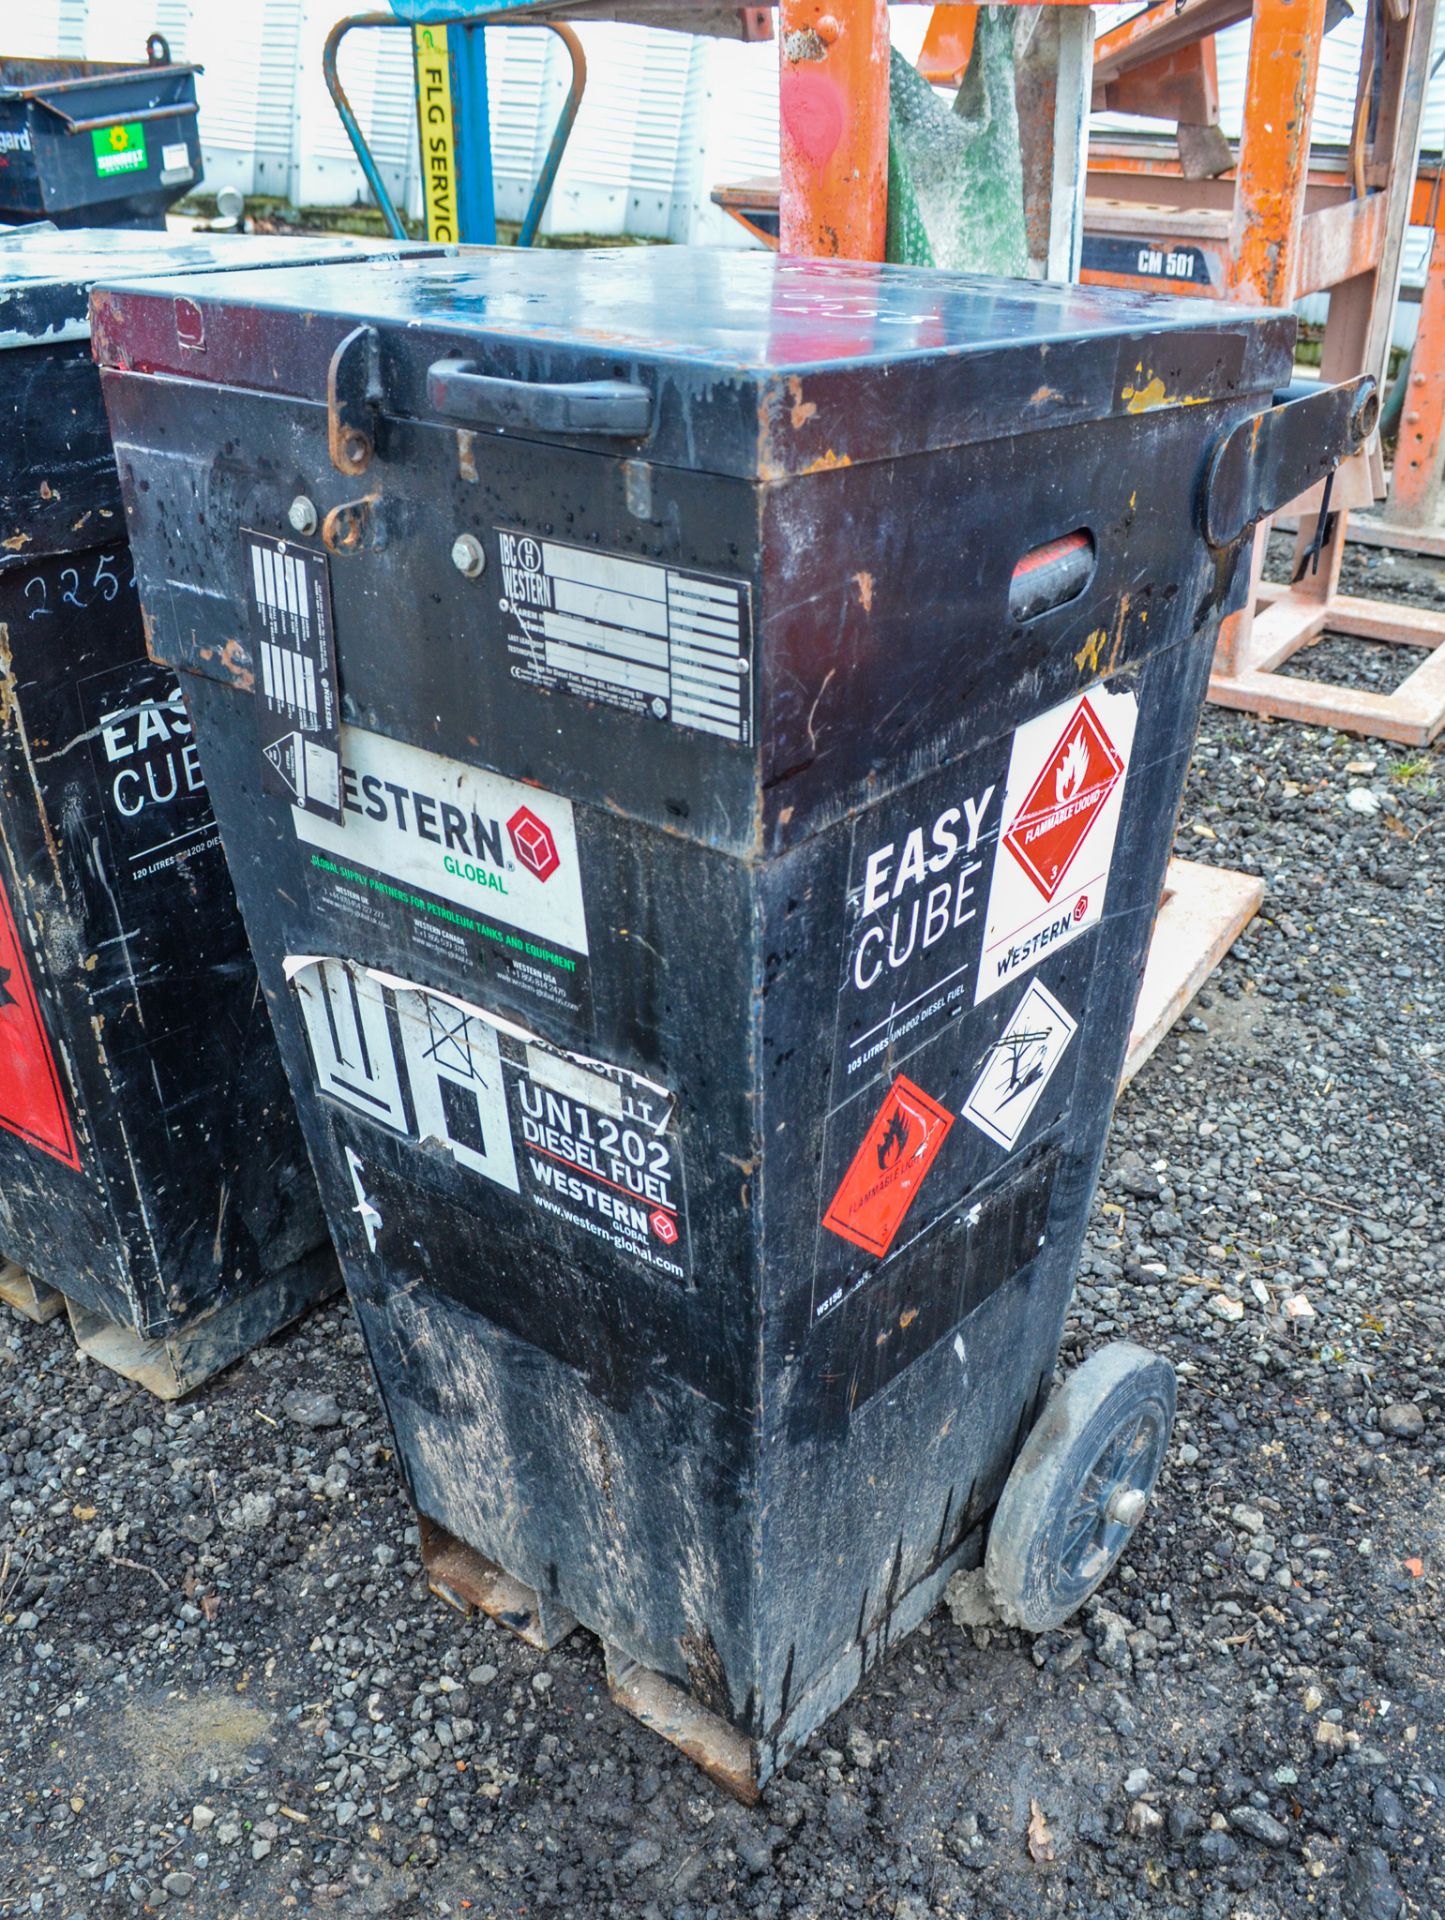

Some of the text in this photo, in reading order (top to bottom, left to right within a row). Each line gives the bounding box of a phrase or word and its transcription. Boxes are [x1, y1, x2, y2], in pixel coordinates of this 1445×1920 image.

[426, 68, 452, 242] FLG SERVIC
[1138, 250, 1194, 277] CM 501
[499, 533, 517, 566] IBC
[502, 566, 552, 608] WESTERN
[1024, 790, 1100, 845] FLAMMABLE LIQUID
[132, 866, 148, 881] 120
[148, 855, 176, 875] LITRES
[443, 855, 509, 895] GLOBAL
[863, 785, 995, 918] EASY
[1050, 864, 1059, 880] 3
[311, 854, 577, 973] GLOBAL SUPPLY PARTNERS FOR PETROLEUM TANKS AND EQUIPMENT
[854, 860, 982, 990] CUBE
[996, 912, 1071, 977] WESTERN
[512, 959, 542, 978] WESTERN
[847, 1055, 863, 1074] 105
[863, 1038, 889, 1065] LITRES
[921, 998, 946, 1022] DIESEL
[947, 984, 965, 1003] FUEL
[517, 1080, 671, 1181] UN1202
[521, 1116, 678, 1209] DIESEL FUEL
[529, 1156, 648, 1234] WESTERN
[533, 1194, 684, 1278] www.western-global.com
[612, 1220, 650, 1246] GLOBAL
